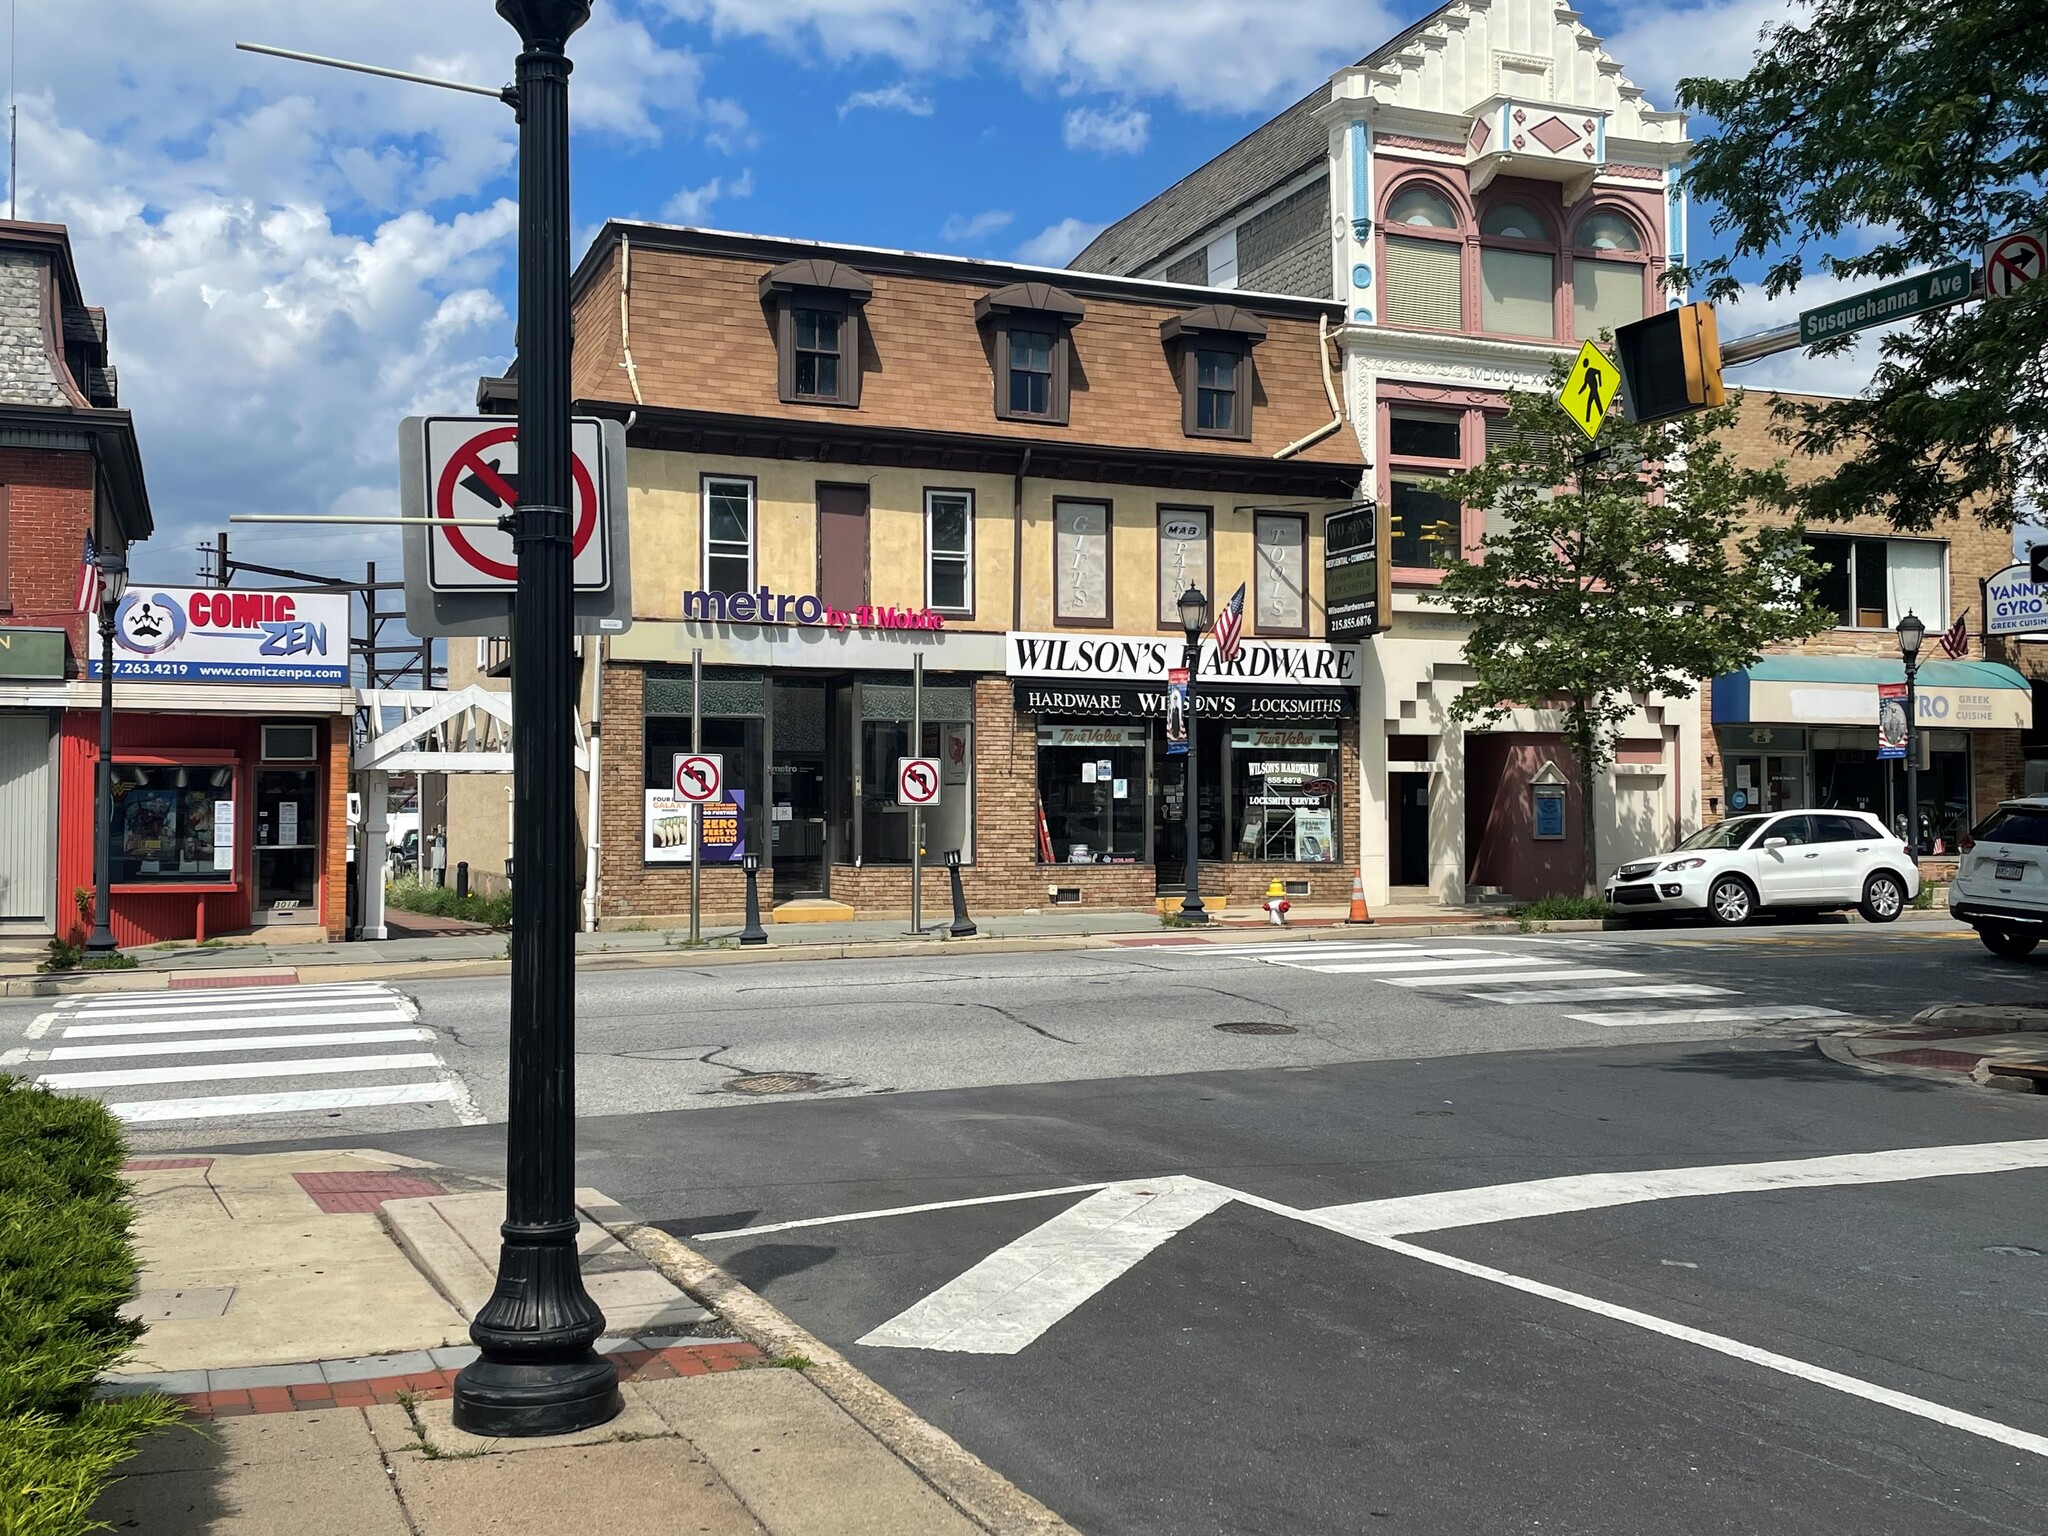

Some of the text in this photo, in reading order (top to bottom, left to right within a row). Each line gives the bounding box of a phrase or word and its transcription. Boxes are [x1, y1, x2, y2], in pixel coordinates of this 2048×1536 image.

[1807, 273, 1962, 336] Susquehanna Ave
[189, 592, 296, 629] COMIC
[683, 585, 823, 625] metro
[825, 604, 850, 632] by
[1996, 599, 2042, 616] GYRO
[1331, 615, 1372, 631] 215.855.6876
[1991, 618, 2046, 630] GREEK CUISIN
[259, 620, 328, 657] ZEN
[1015, 638, 1168, 675] WILSON'S
[94, 662, 342, 680] 27.263.4219 www.comiczenpa.com
[1028, 692, 1342, 713] HARDWARE WISON'S LOCKSMITHS
[1958, 695, 1990, 704] GREEK
[1955, 711, 1993, 721] CUISINE
[1248, 762, 1319, 777] WILSON'S HARDWARE
[1302, 781, 1338, 793] OPEN
[1249, 796, 1320, 806] LOCKSMITH SERVICE
[703, 819, 738, 829] ZERO
[703, 835, 738, 843] SWITCH
